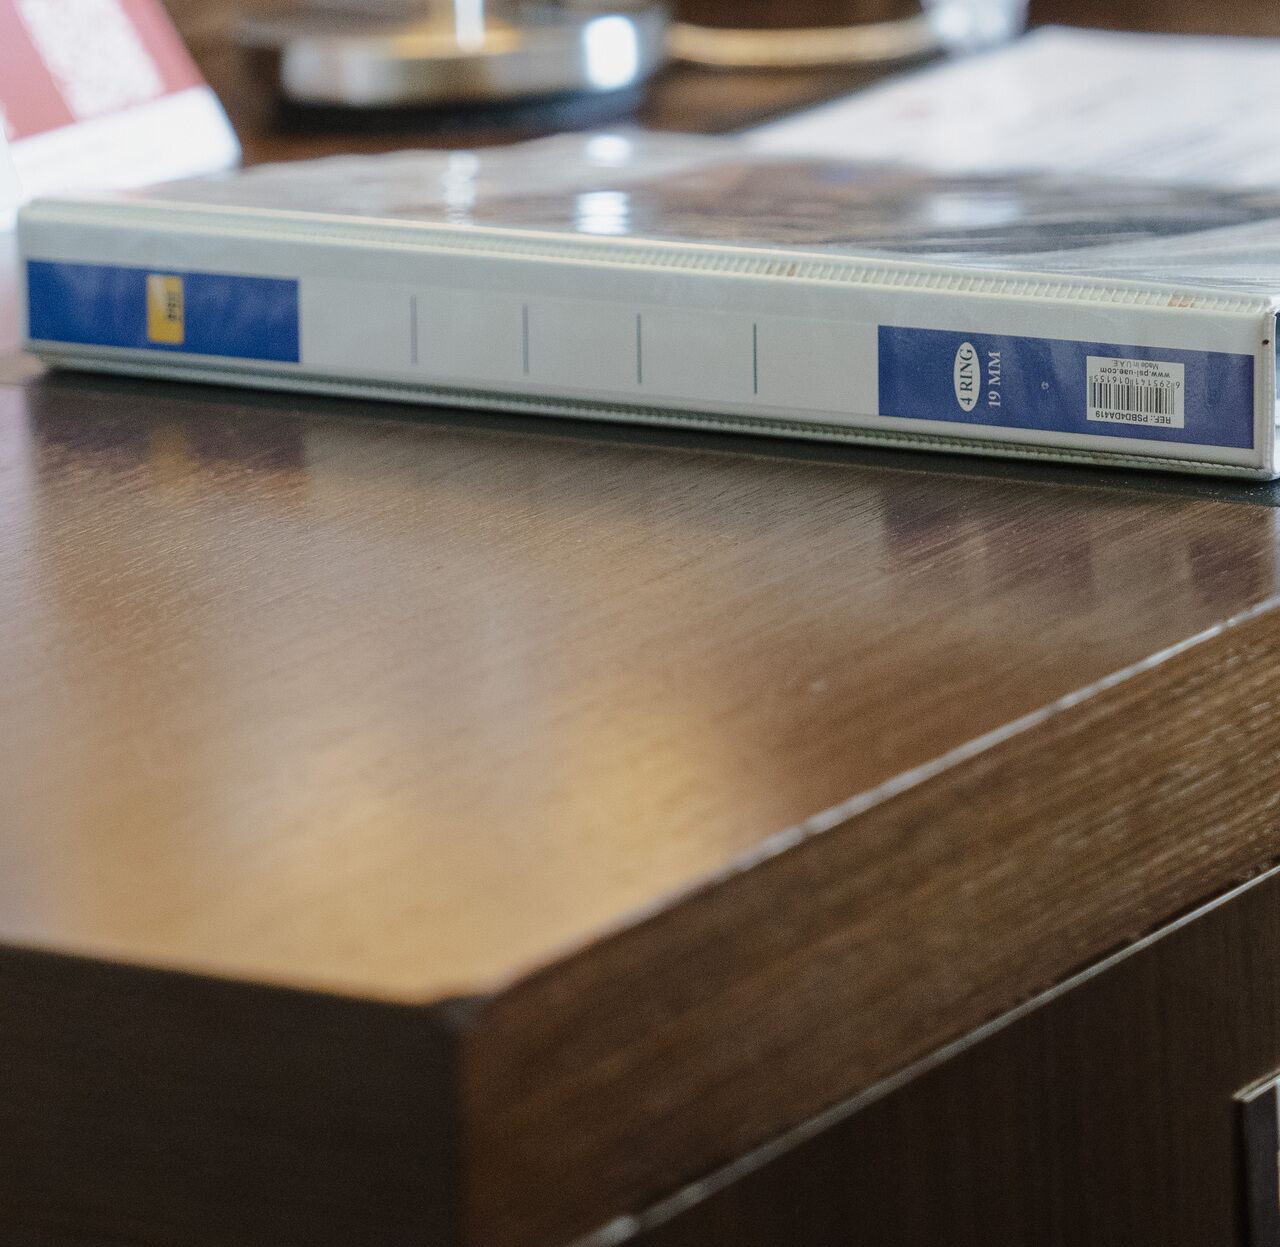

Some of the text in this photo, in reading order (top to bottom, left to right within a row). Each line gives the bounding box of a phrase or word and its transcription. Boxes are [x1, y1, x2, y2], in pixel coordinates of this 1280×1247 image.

[959, 348, 973, 392] RING
[1141, 362, 1159, 370] Made
[988, 351, 1001, 408] 19 MM
[1099, 367, 1171, 379] www.psi-uae.com
[1095, 410, 1149, 423] PSBD4DA419
